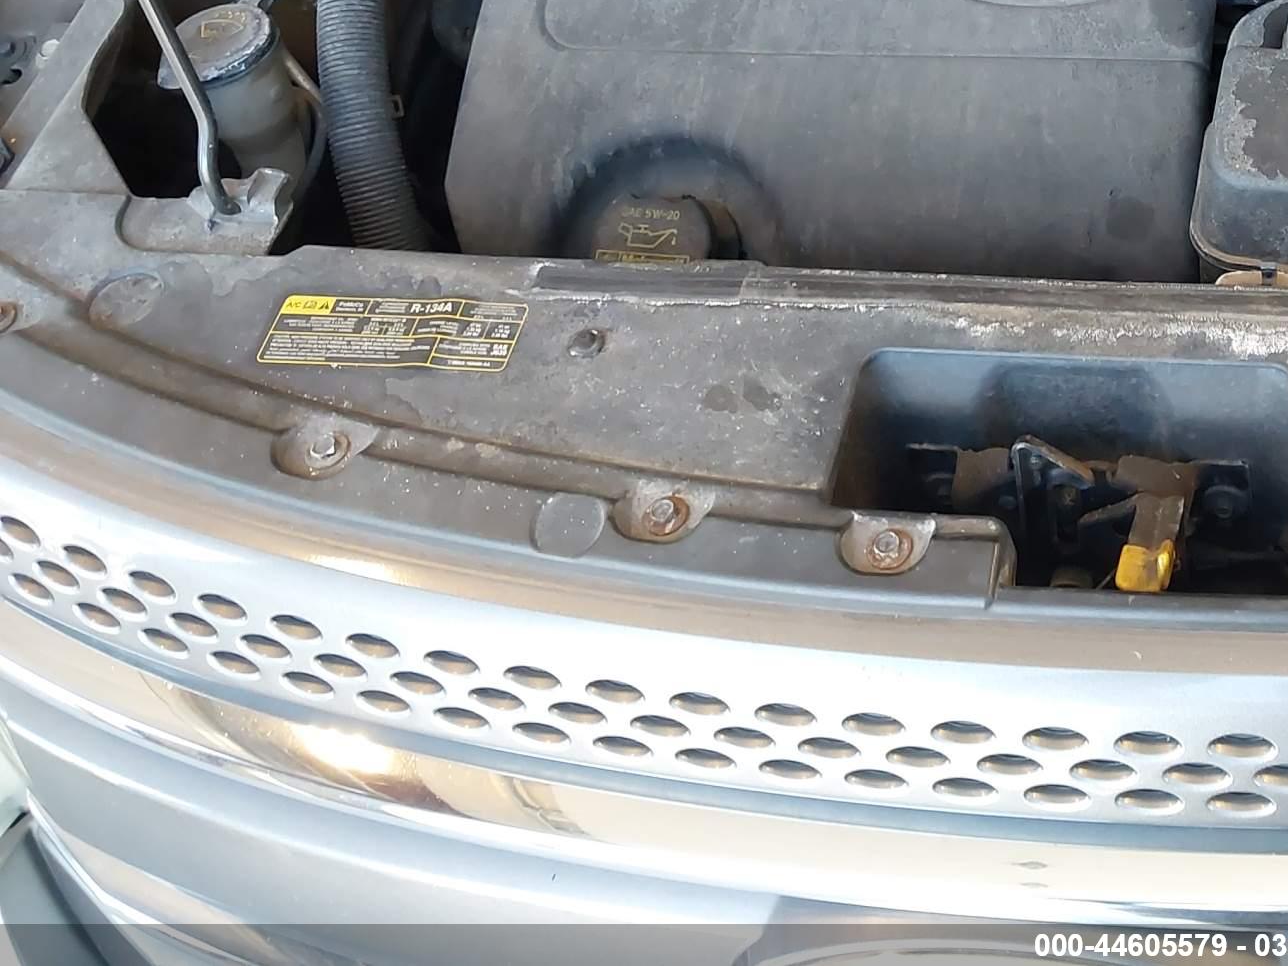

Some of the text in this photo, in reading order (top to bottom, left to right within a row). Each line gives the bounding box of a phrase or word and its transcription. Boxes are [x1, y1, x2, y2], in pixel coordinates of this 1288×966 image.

[645, 208, 681, 220] 5W-20
[286, 300, 302, 310] A/C
[410, 302, 453, 314] R-134A
